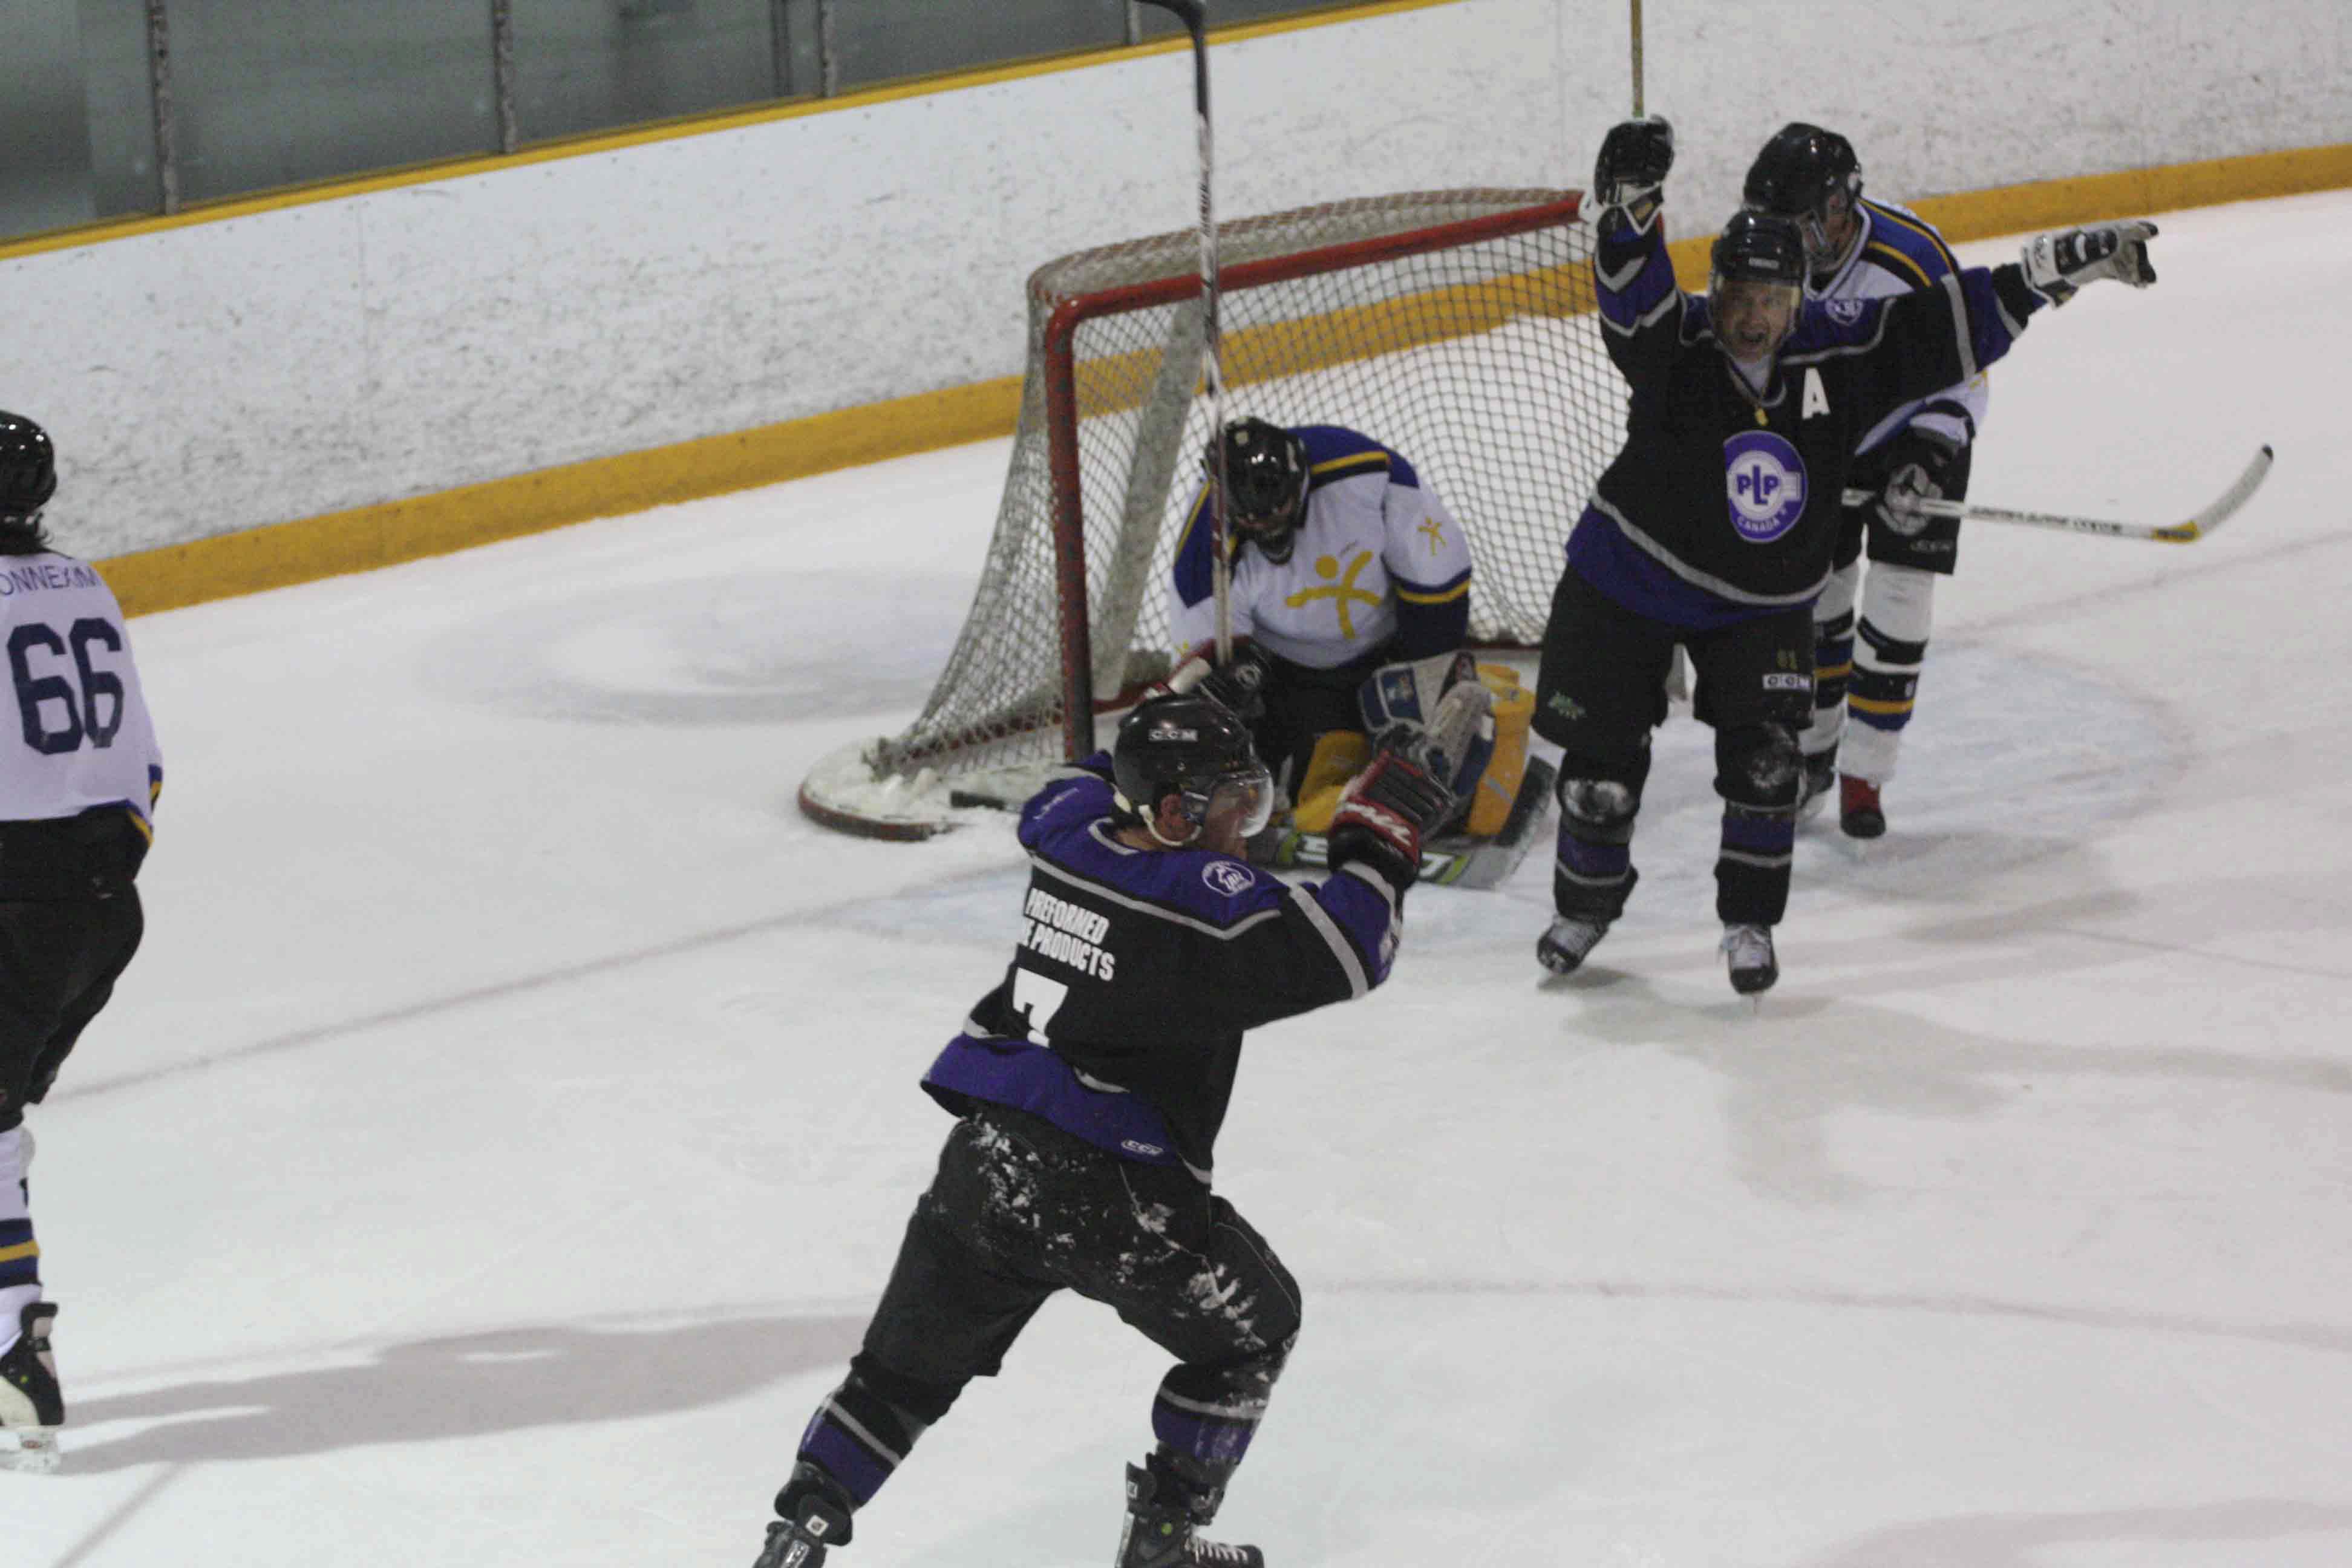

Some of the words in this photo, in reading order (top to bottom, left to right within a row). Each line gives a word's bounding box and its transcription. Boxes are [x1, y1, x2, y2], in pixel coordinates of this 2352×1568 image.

[1802, 367, 1831, 420] A
[7, 618, 124, 755] 66
[1149, 728, 1198, 742] CCM
[1029, 923, 1116, 982] PRODUCTS
